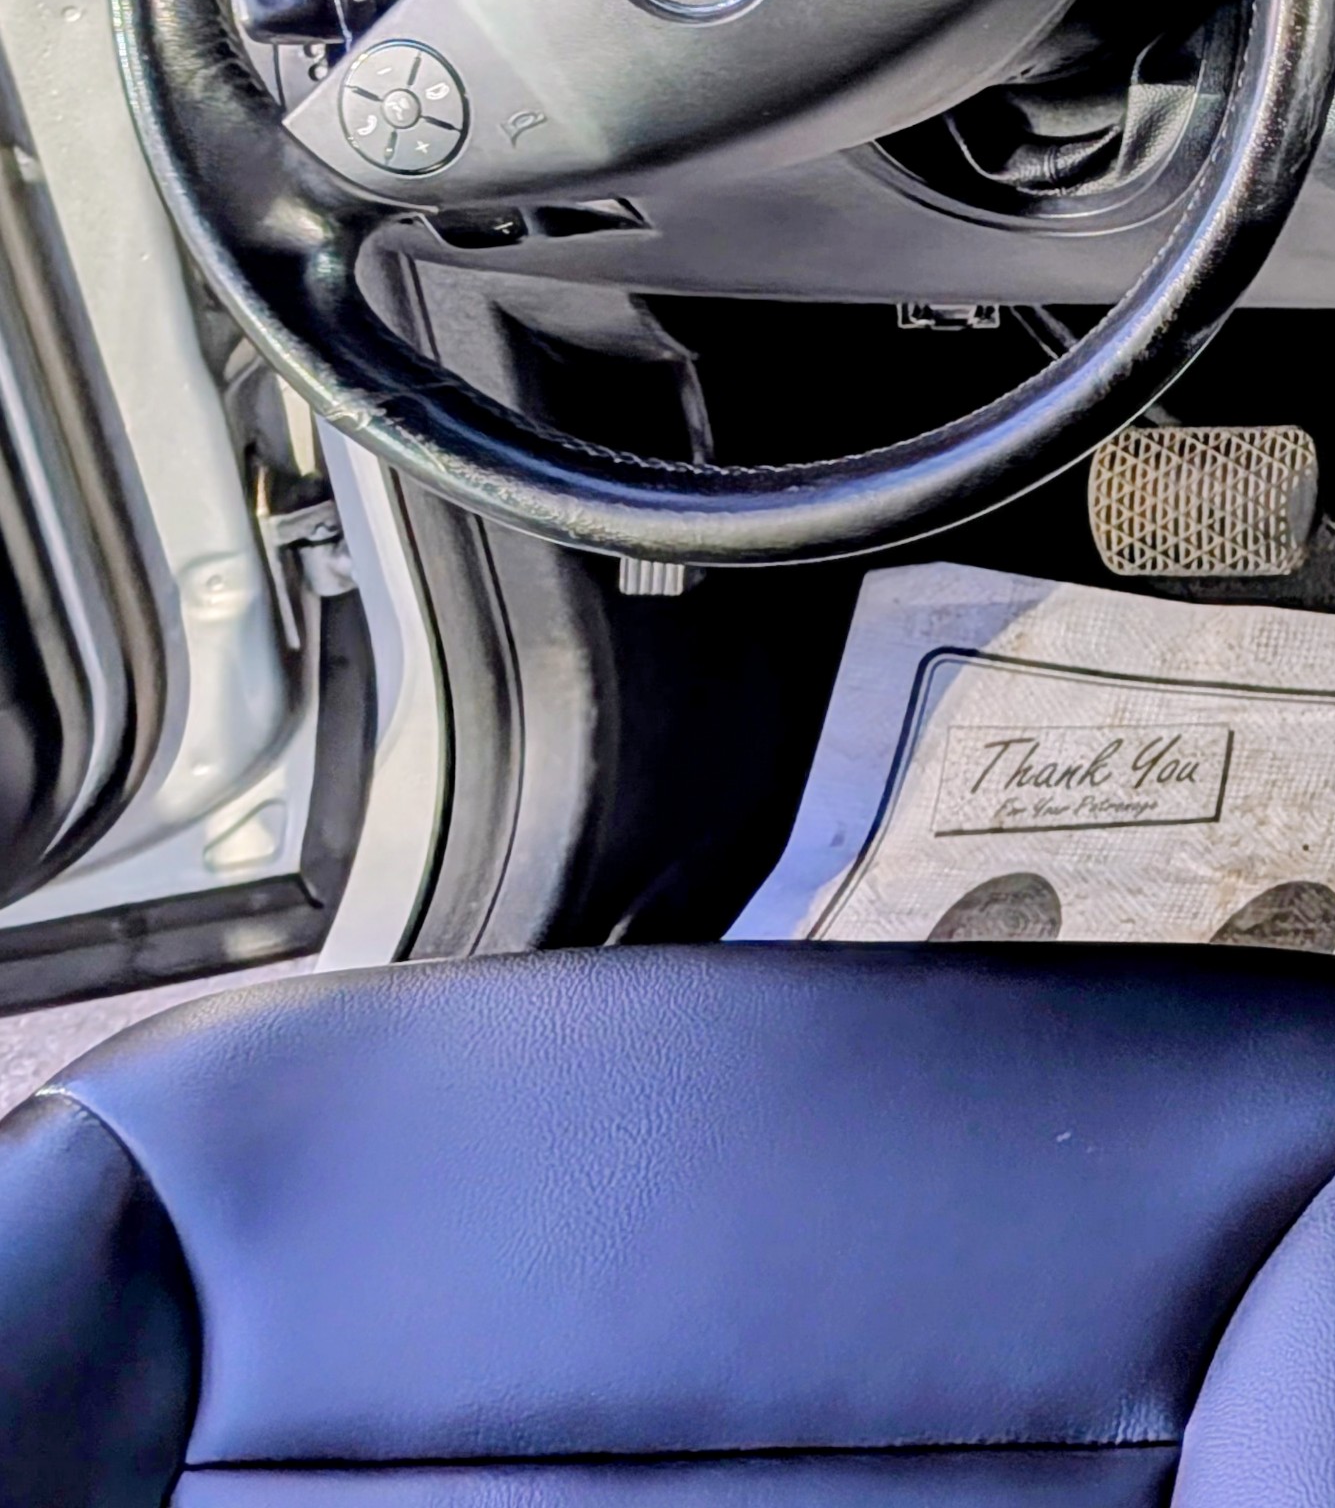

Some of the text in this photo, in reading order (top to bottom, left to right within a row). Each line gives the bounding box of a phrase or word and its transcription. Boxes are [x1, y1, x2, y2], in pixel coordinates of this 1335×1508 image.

[970, 733, 1198, 795] Thank You
[994, 798, 1021, 819] For
[1031, 796, 1070, 818] Your
